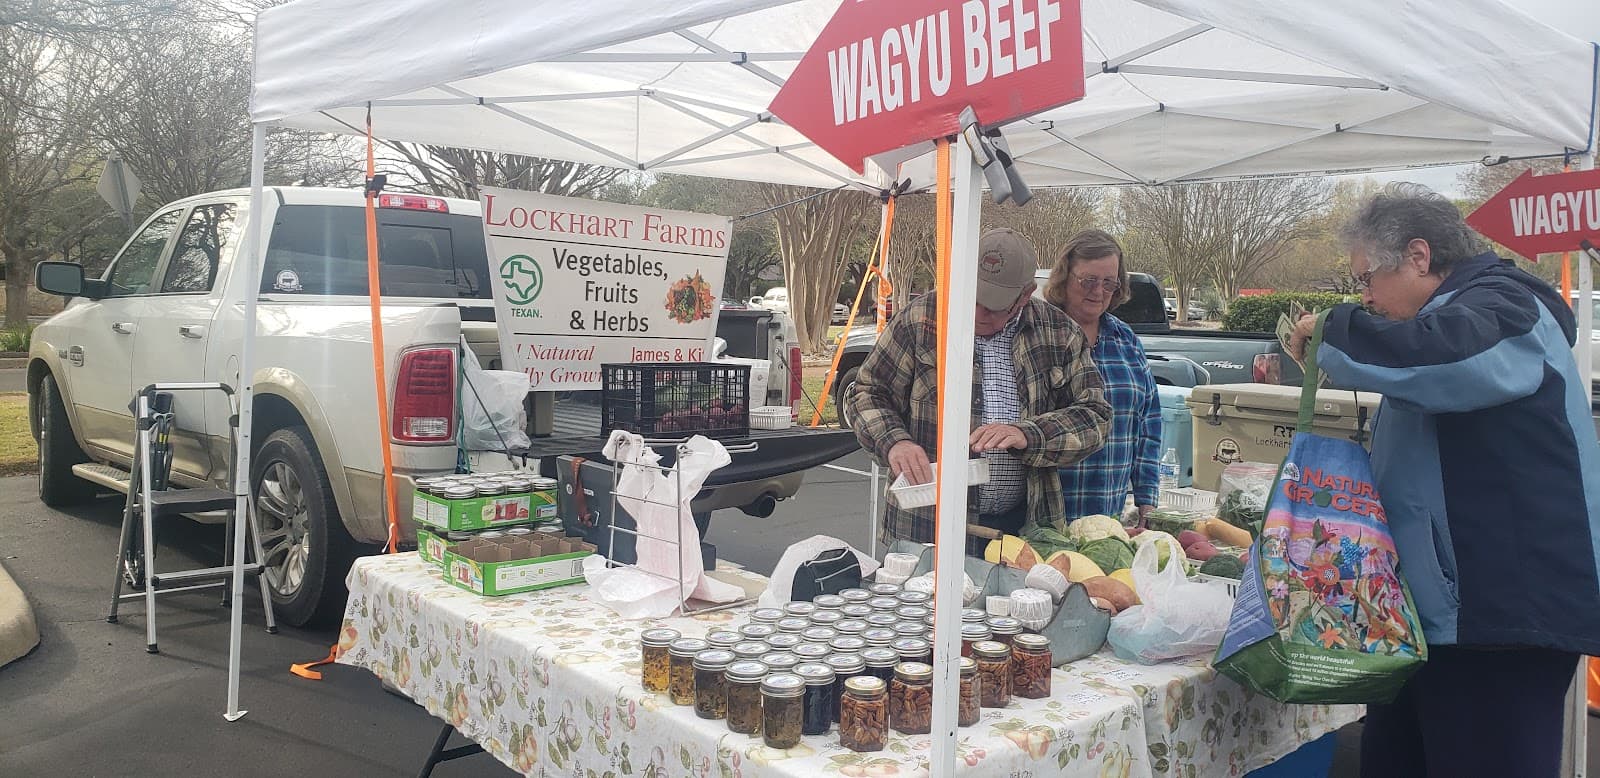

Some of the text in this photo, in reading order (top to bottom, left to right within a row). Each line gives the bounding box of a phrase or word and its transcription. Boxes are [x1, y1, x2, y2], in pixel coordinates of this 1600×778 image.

[828, 0, 1061, 126] WAGYU BEEF
[1509, 188, 1600, 237] WAGYU
[552, 247, 668, 281] Vegetables,
[585, 280, 638, 304] Fruits
[569, 310, 649, 332] & Herbs
[527, 344, 595, 361] Natural
[631, 346, 705, 363] James & Ki
